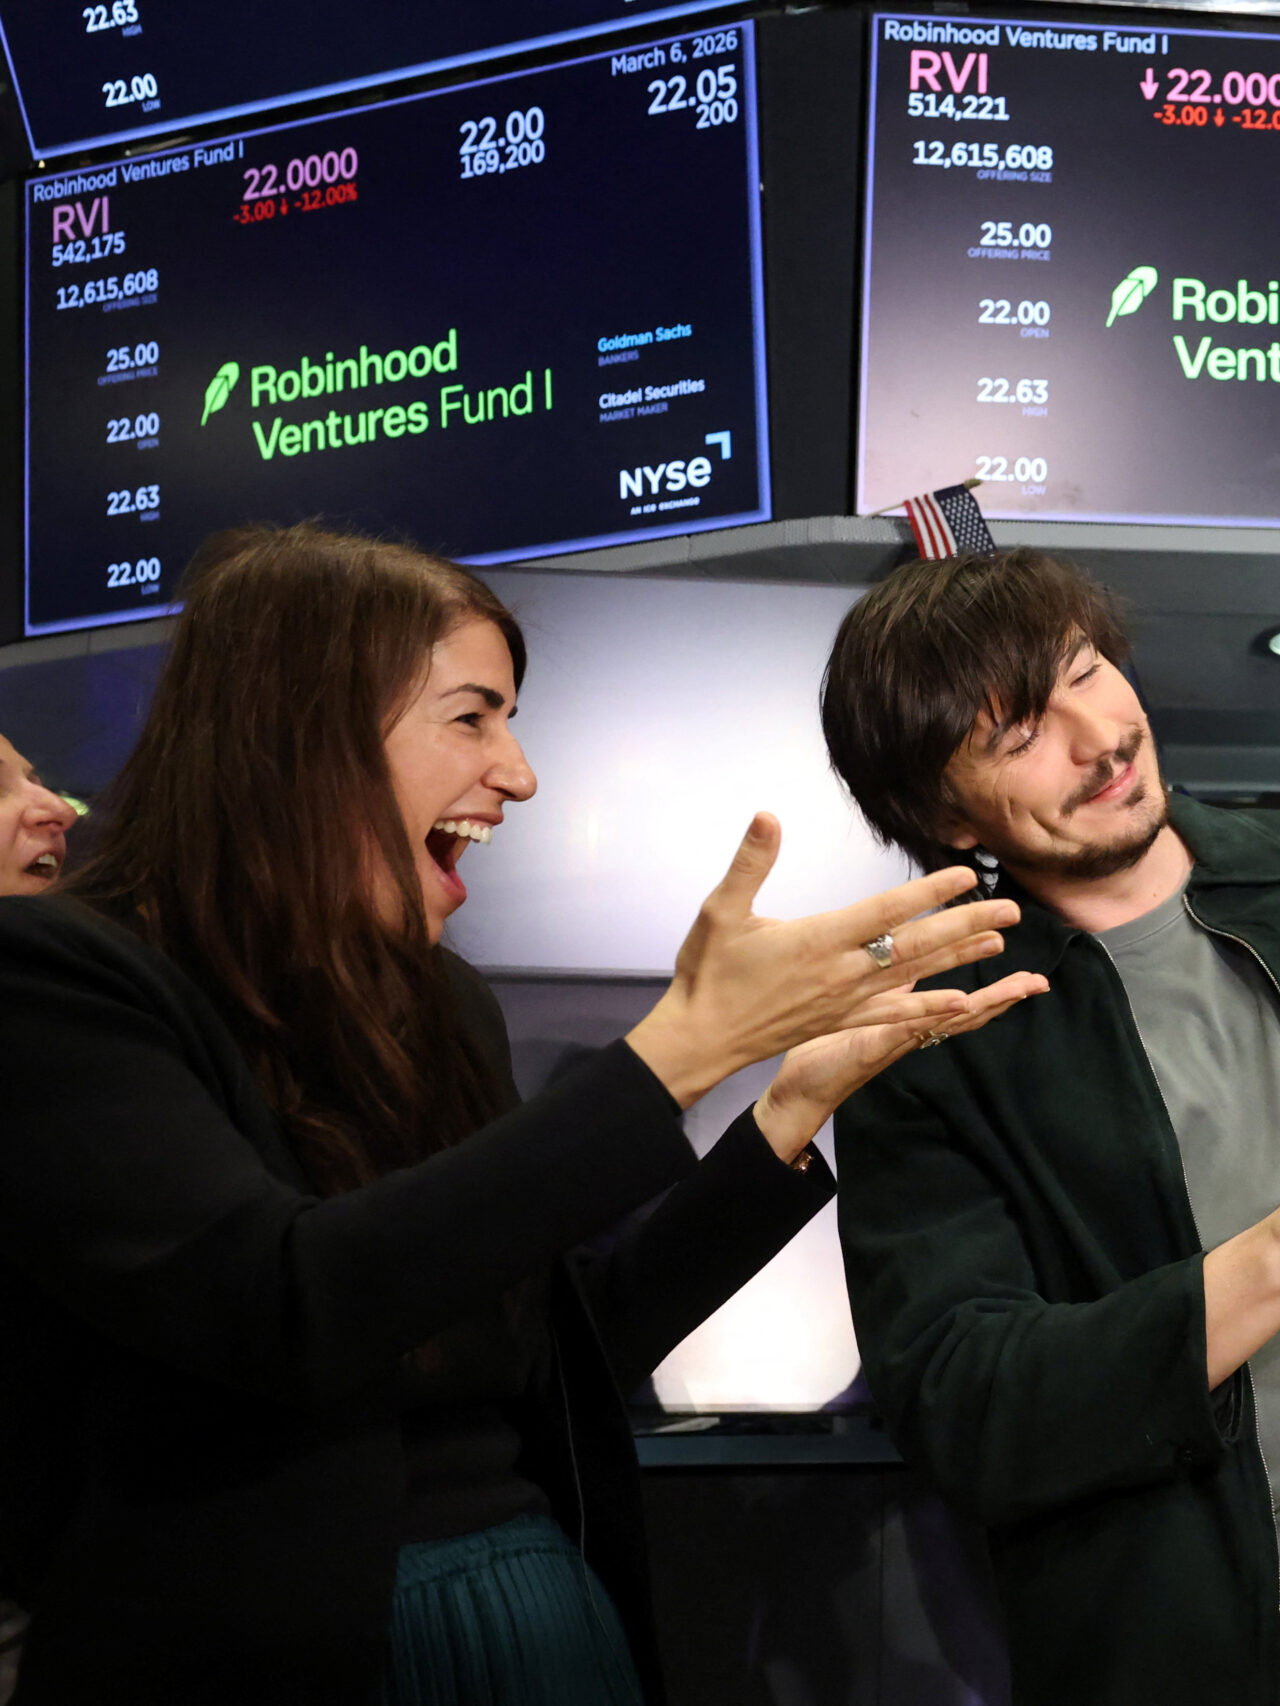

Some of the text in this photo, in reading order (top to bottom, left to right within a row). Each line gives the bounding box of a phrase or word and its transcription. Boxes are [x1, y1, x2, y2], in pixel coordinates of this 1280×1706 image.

[82, 0, 139, 33] 22.63
[611, 29, 738, 76] March 6, 2026
[884, 20, 1000, 47] Robinhood
[1006, 26, 1098, 52] Ventures
[1103, 32, 1155, 54] Fund
[909, 49, 988, 94] RVI
[102, 73, 158, 107] 22.00
[647, 63, 737, 115] 22.05
[696, 98, 738, 129] 200
[907, 92, 1009, 120] 514,221
[1153, 104, 1208, 126] -3.00
[459, 106, 544, 155] 22.00
[34, 167, 118, 202] Robinhood
[121, 154, 190, 183] Ventures
[194, 141, 234, 168] Fund
[460, 139, 545, 179] 169,200
[912, 140, 1053, 170] 12,615,608
[243, 147, 358, 201] 22.0000
[53, 196, 109, 243] RVI
[233, 182, 357, 224] -3.00 -12.00%
[52, 231, 126, 266] 542,175
[980, 222, 1052, 248] 25.00
[56, 268, 159, 310] 12,615,608
[978, 298, 1050, 326] 22.00
[597, 323, 692, 352] Goldman Sachs
[106, 341, 159, 372] 25.00
[251, 328, 458, 406] Robinhood
[599, 378, 706, 409] Citadel Securities
[976, 377, 1048, 404] 22.63
[106, 412, 159, 443] 22.00
[253, 399, 429, 460] Ventures
[440, 370, 532, 429] Fund
[975, 455, 1047, 483] 22.00
[107, 484, 160, 516] 22.63
[107, 557, 161, 588] 22.00
